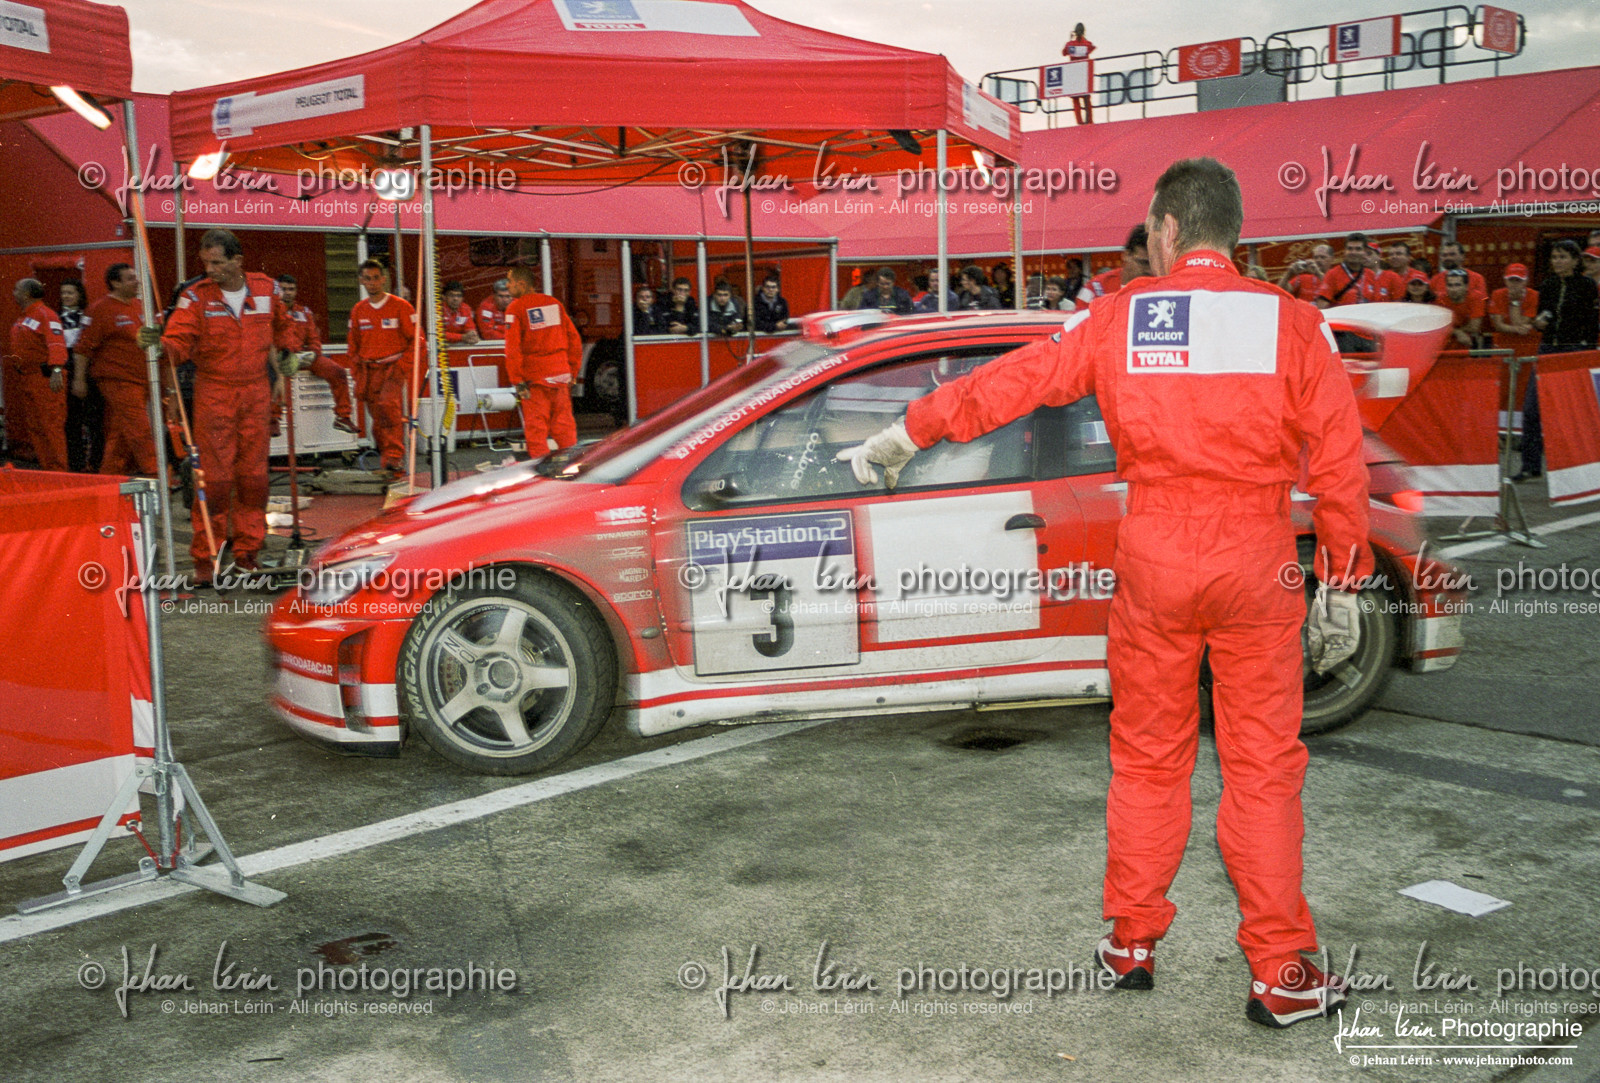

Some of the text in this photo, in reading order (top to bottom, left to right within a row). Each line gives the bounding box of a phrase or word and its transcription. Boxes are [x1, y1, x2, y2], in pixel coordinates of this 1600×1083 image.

[0, 15, 39, 37] OTAL
[296, 87, 358, 108] PEUGEOT TOTAL
[1138, 331, 1184, 342] PEUGEOT
[1137, 352, 1184, 366] TOTAL
[688, 352, 850, 451] PEUGEOT FINANCEMENT
[791, 432, 819, 490] sparco
[609, 505, 648, 520] NGK
[750, 573, 795, 658] 3
[404, 593, 459, 720] MICHELIN
